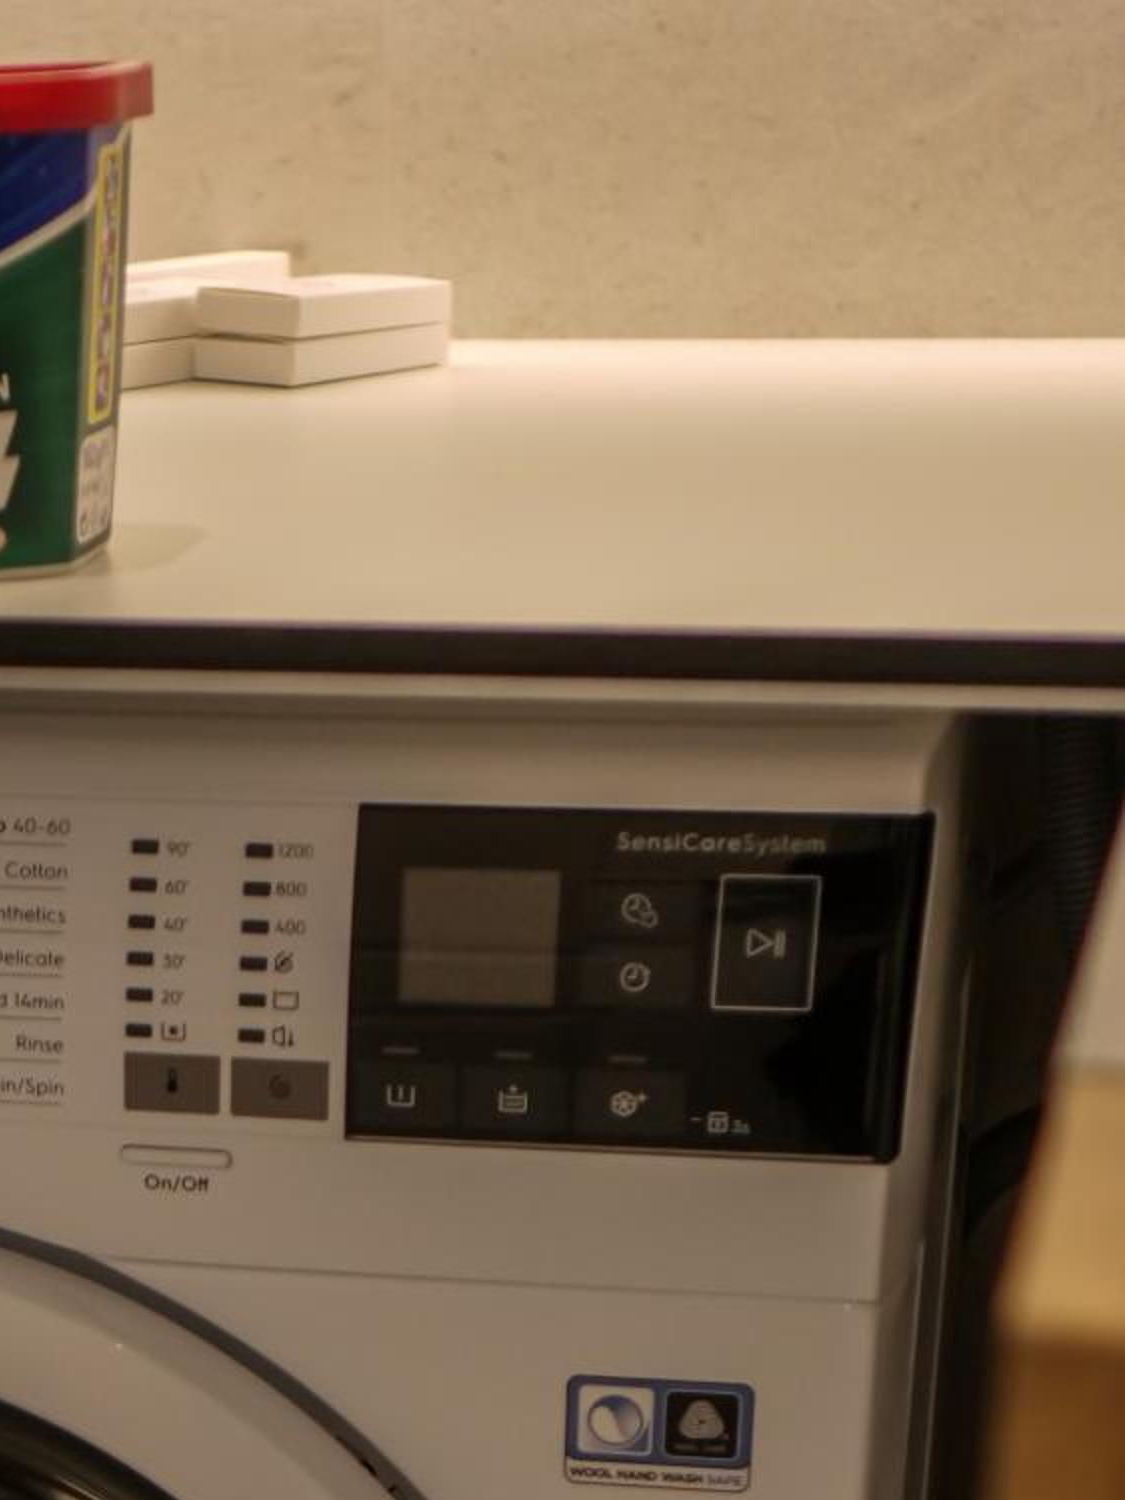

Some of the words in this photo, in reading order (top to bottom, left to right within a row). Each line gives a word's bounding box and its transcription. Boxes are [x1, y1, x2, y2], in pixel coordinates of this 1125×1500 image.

[13, 817, 71, 836] 40-60
[278, 843, 314, 859] 1200
[617, 831, 828, 856] SensiCareSystem
[4, 861, 69, 880] Cotton
[274, 920, 306, 935] 400
[13, 992, 65, 1010] 14min
[15, 1034, 64, 1054] Rinse
[144, 1174, 209, 1193] On/Off
[570, 1468, 613, 1480] WOOL
[617, 1470, 658, 1482] HAND
[662, 1472, 705, 1484] WASH
